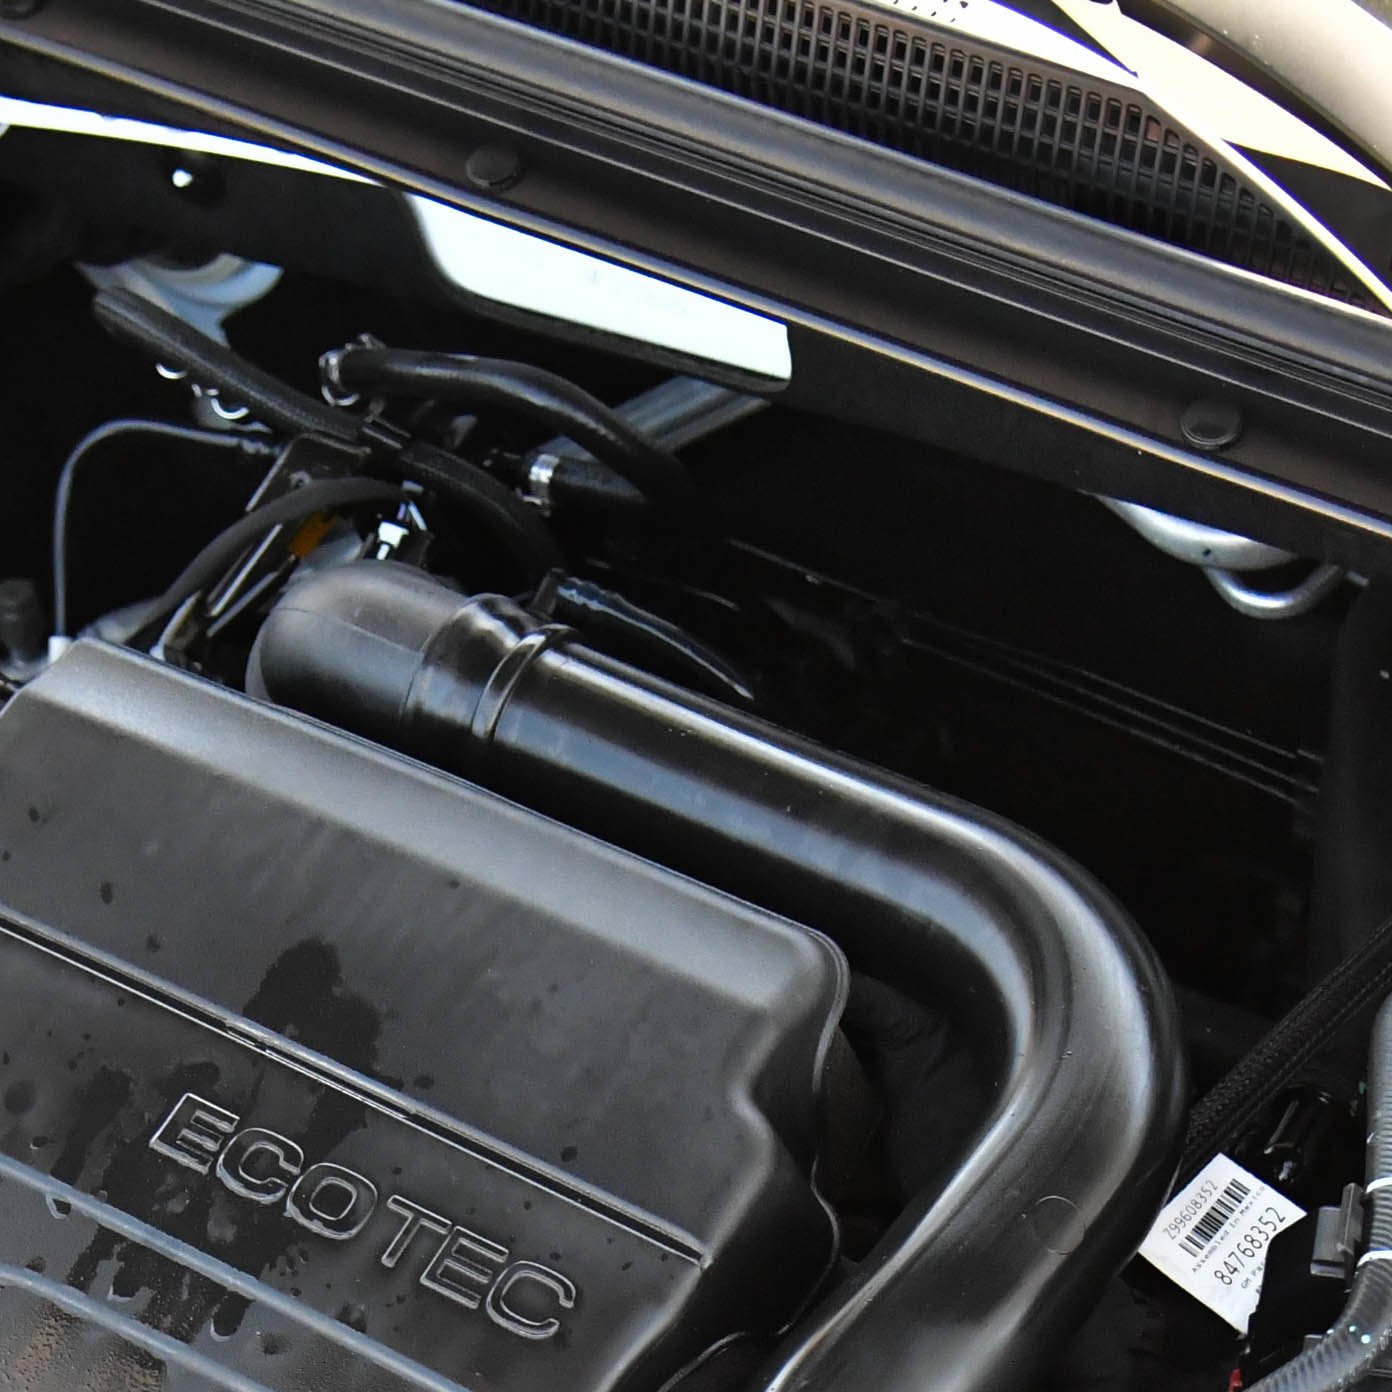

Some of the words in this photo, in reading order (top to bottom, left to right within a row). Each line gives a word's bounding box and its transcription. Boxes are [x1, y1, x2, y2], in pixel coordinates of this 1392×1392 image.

[149, 1092, 578, 1341] ECOTEC
[1193, 1231, 1230, 1272] Assembled
[1240, 1186, 1265, 1215] Mexico
[1214, 1207, 1286, 1286] 84768352
